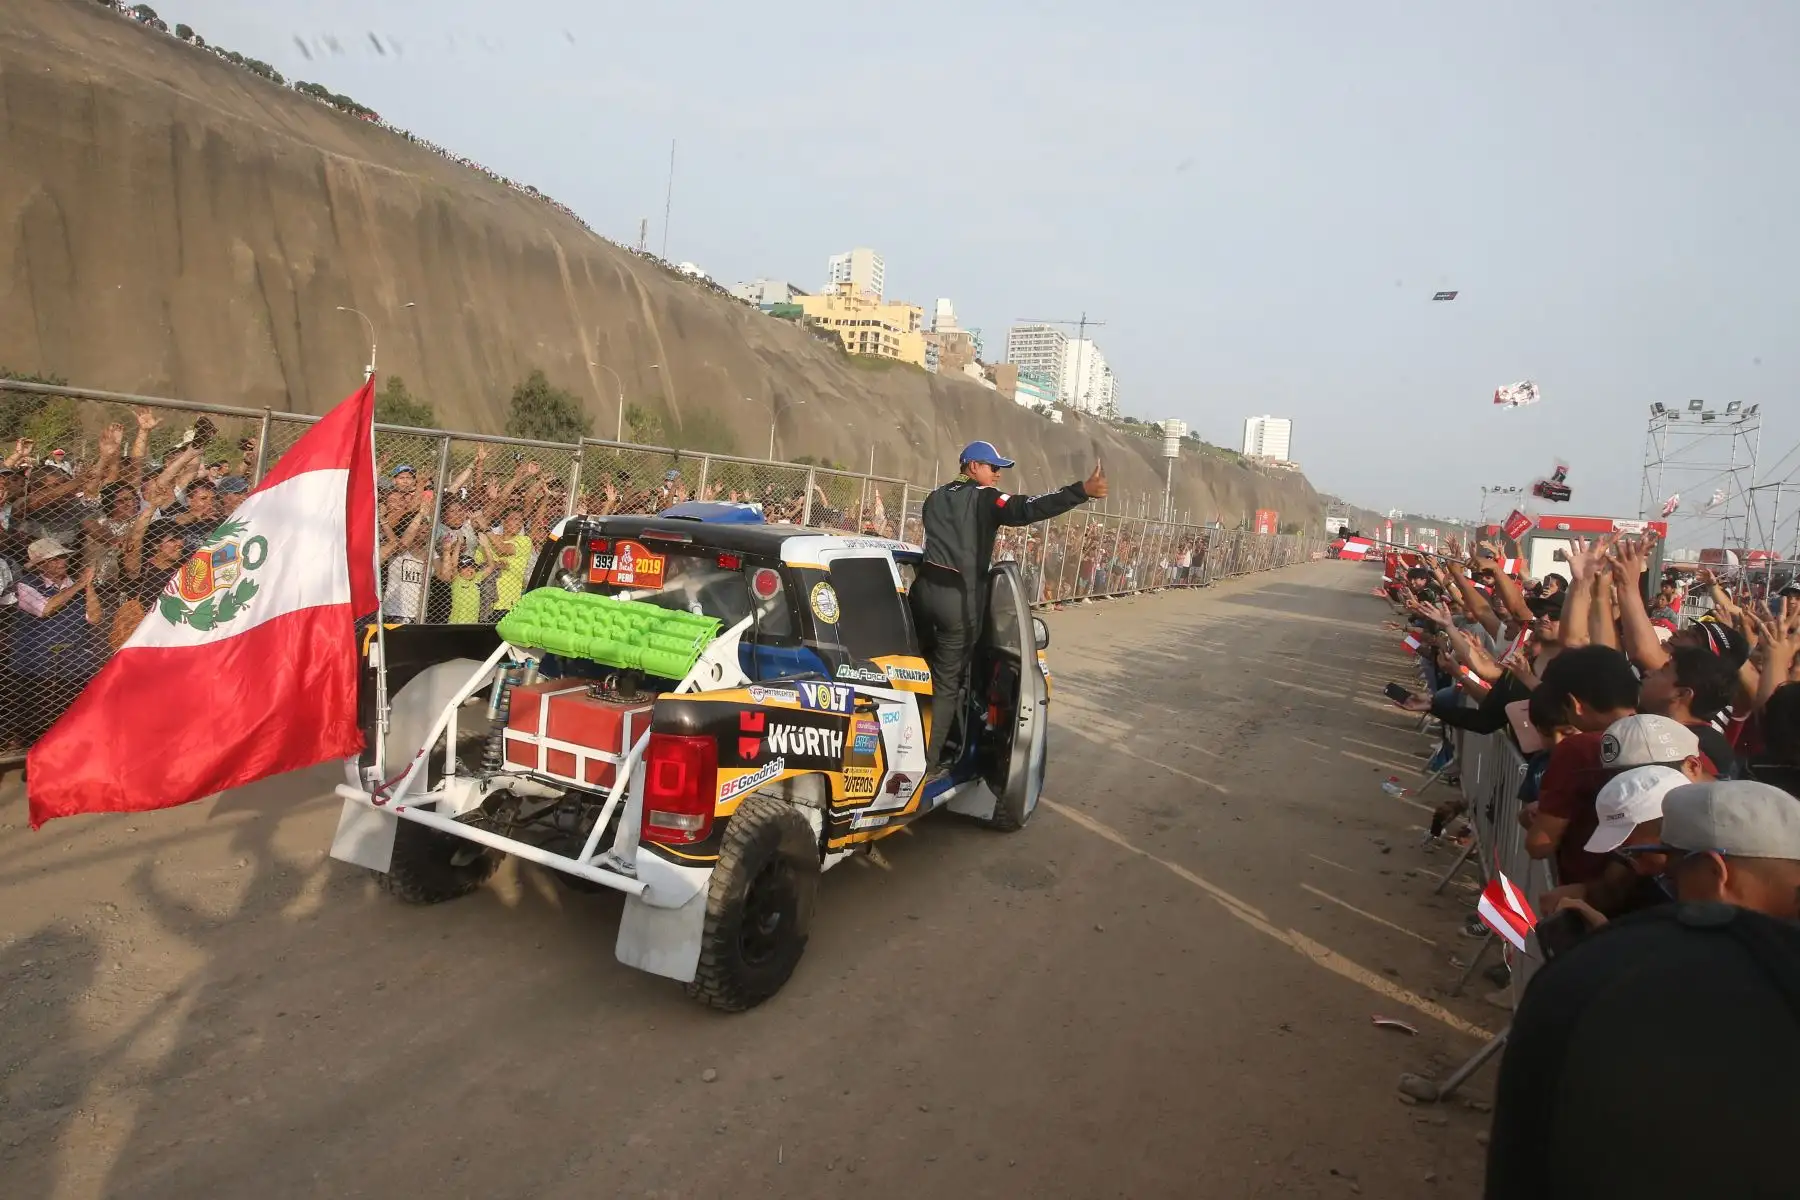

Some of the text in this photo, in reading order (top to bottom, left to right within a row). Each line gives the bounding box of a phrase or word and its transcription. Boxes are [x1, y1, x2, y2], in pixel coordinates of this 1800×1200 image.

[595, 555, 613, 568] 393
[636, 559, 660, 574] 2019
[800, 681, 850, 712] VOLT
[767, 722, 844, 759] WÜRTH
[720, 757, 785, 798] BFGoodrich
